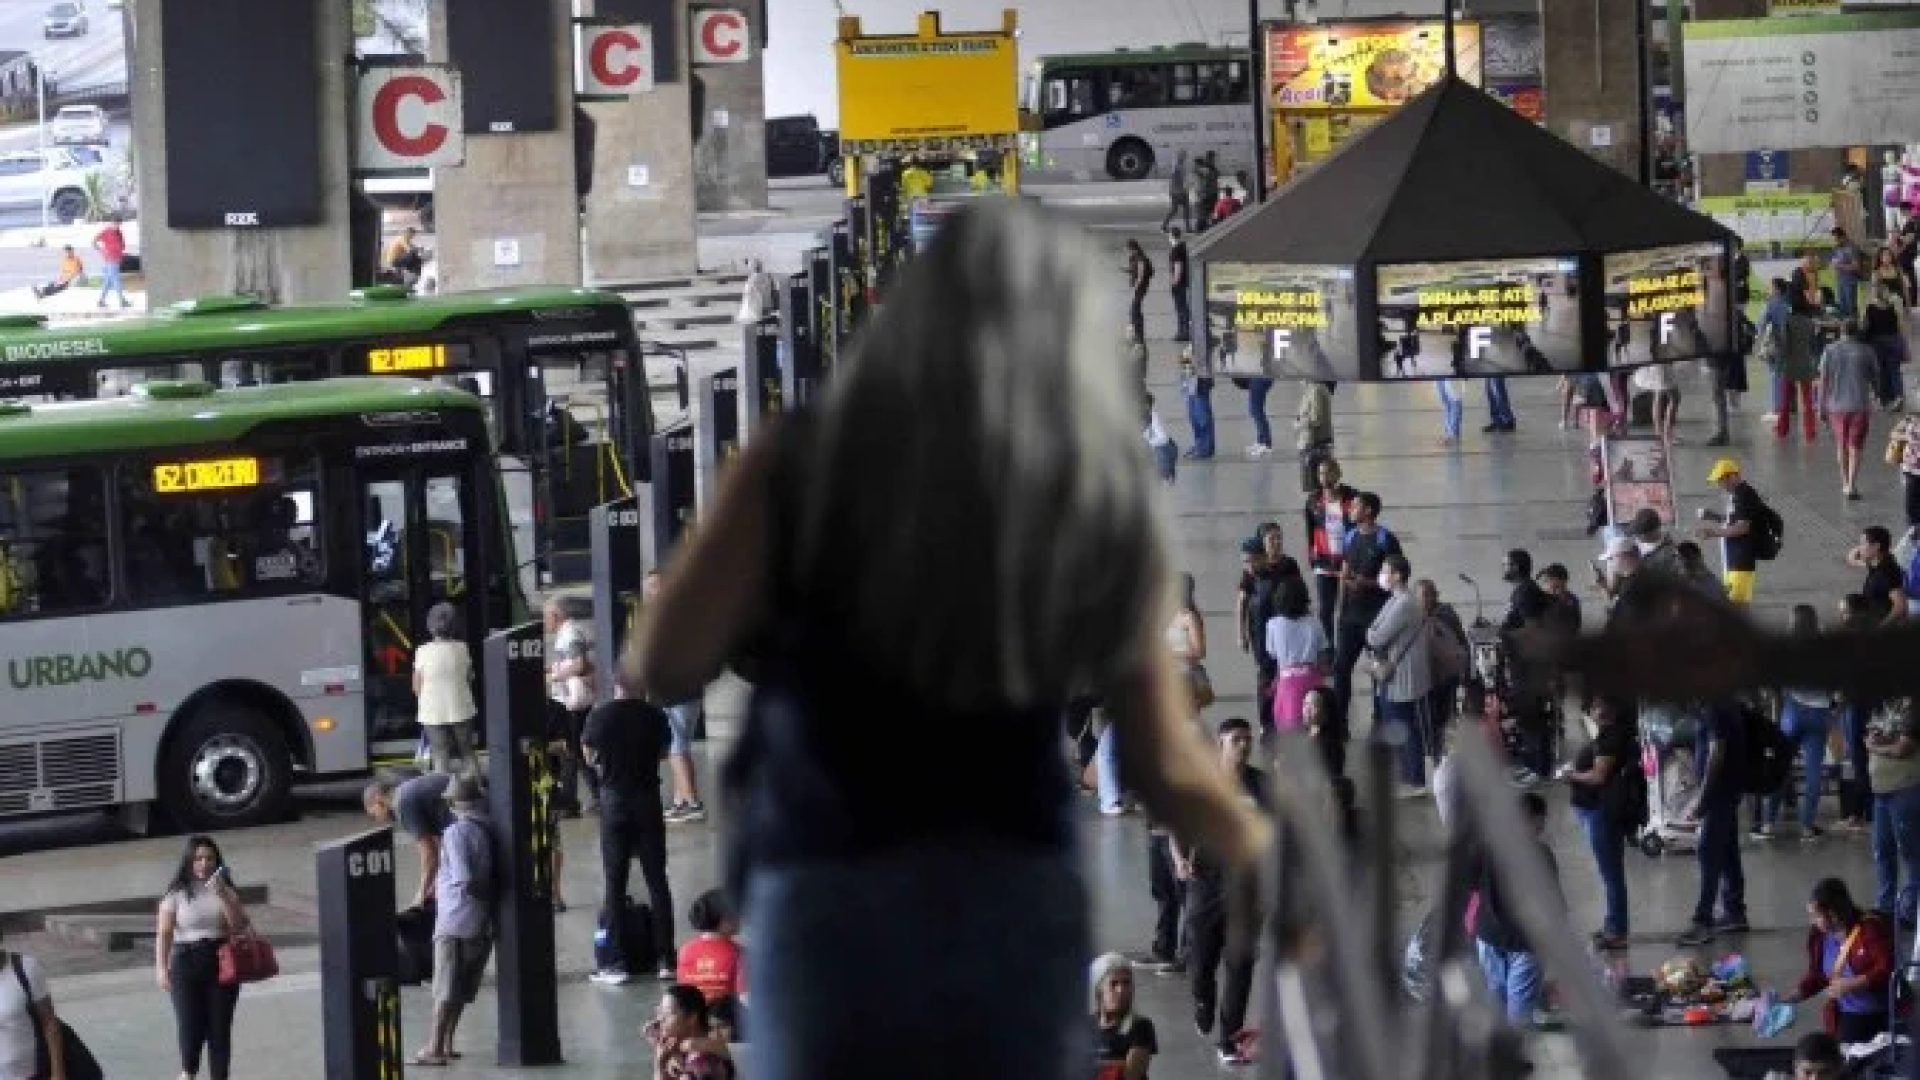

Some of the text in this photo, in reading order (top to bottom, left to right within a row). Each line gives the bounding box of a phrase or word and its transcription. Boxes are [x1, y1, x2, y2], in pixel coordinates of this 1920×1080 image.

[702, 14, 742, 56] C
[589, 30, 641, 86] C
[372, 75, 448, 157] C
[1273, 329, 1292, 359] F
[1468, 326, 1492, 359] F
[1660, 312, 1677, 345] F
[5, 338, 109, 361] BIODIESEL
[508, 641, 519, 660] C
[8, 648, 152, 690] URBANO
[350, 850, 391, 877] C 01
